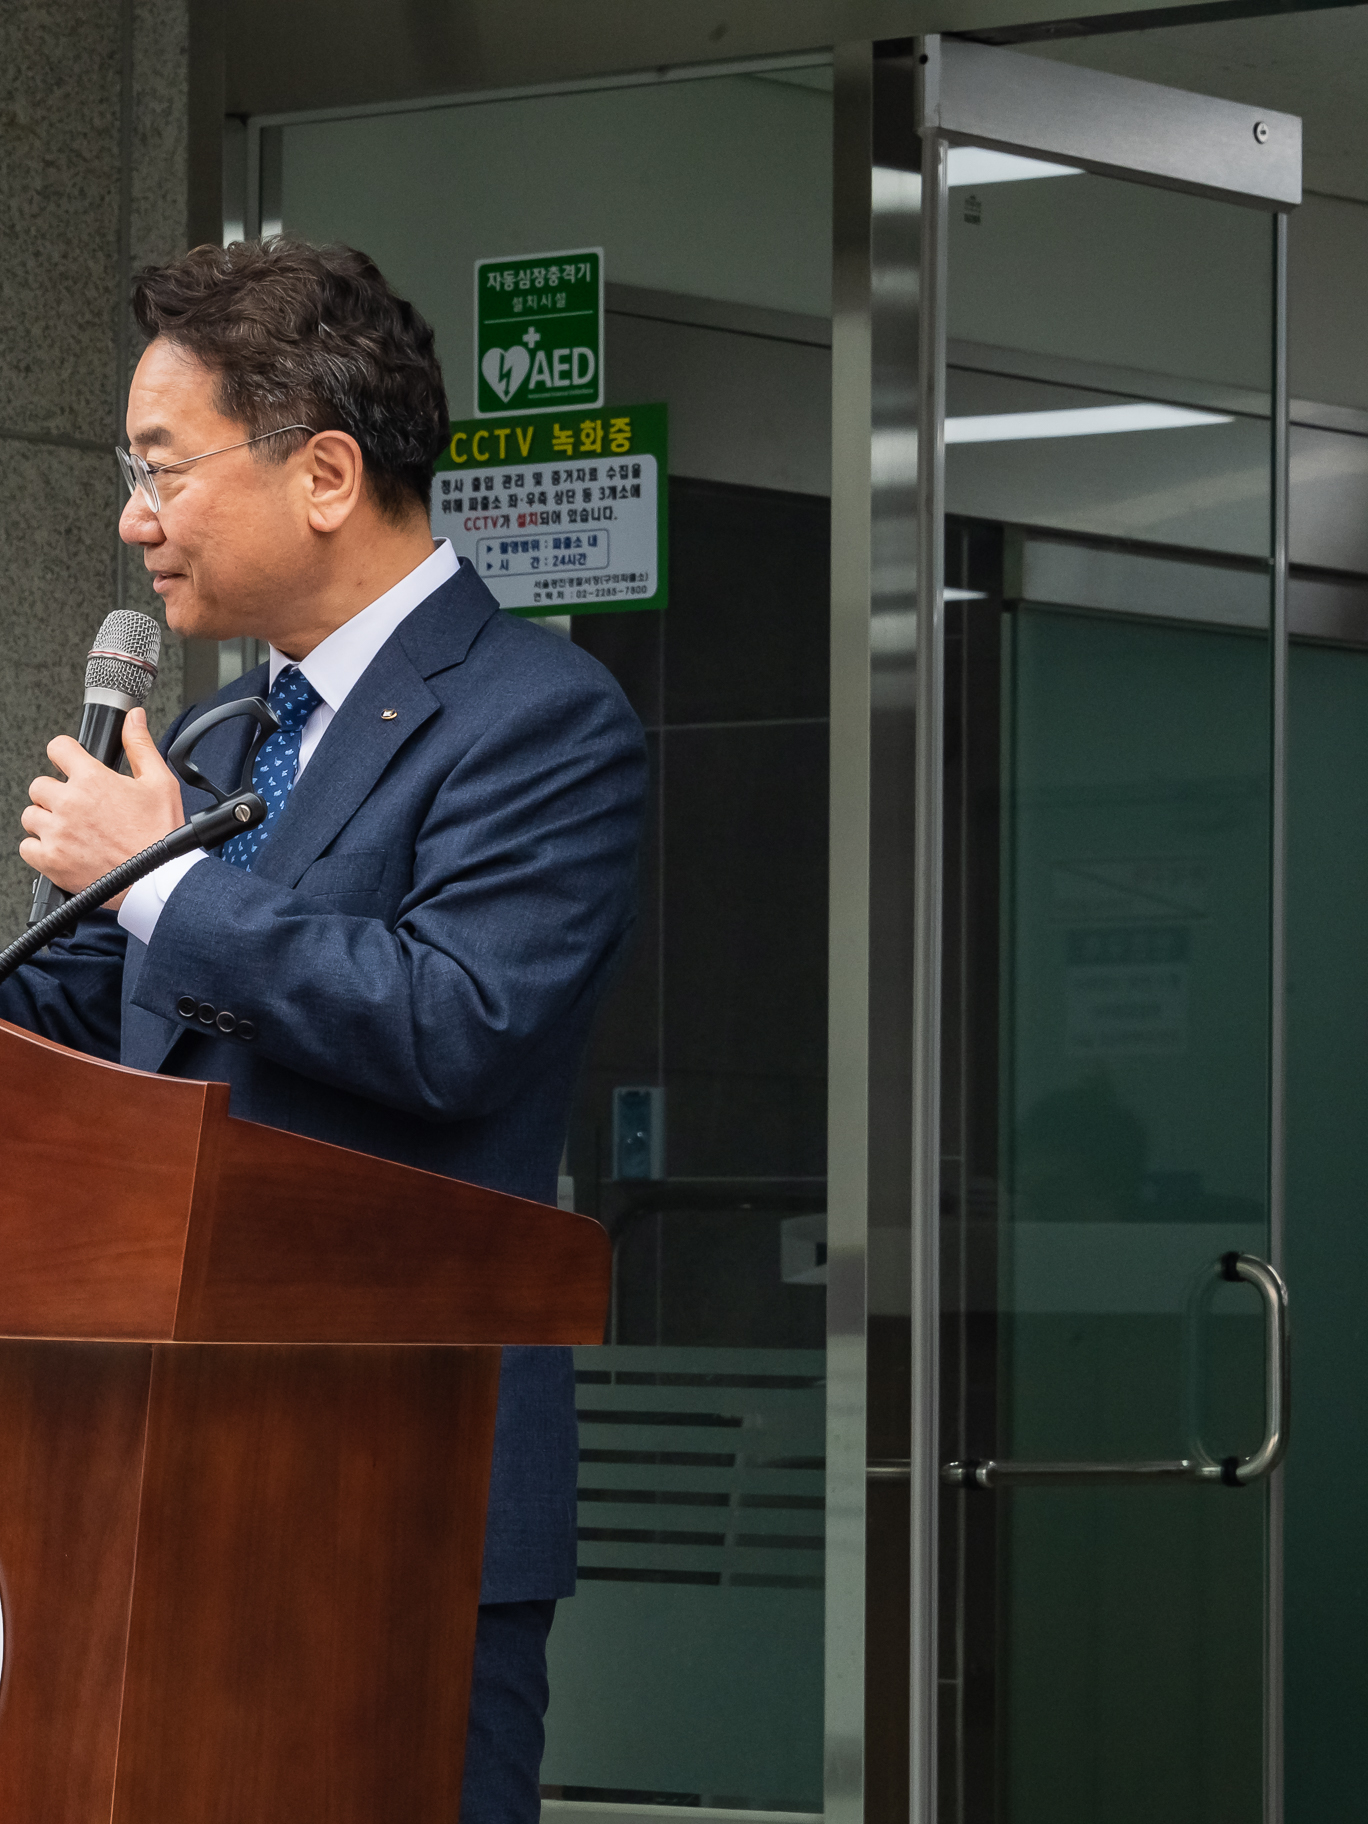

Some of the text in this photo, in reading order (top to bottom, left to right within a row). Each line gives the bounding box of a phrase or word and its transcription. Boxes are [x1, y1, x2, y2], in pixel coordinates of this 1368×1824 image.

[486, 262, 592, 292] 자동심장충격기
[511, 292, 567, 313] 설치시설
[528, 346, 596, 390] AED
[449, 416, 632, 464] CCTV 녹화중
[440, 463, 642, 495] 청사 출입 관리 및 증거자료 수집을
[440, 498, 463, 515] 위해
[467, 495, 502, 512] 파출소
[552, 488, 576, 506] 상단
[581, 487, 593, 503] 등
[598, 483, 642, 501] 3개소에
[463, 506, 619, 533] CCTV가 설치되어 있습니다.
[552, 536, 583, 550] 파출소
[587, 534, 598, 547] 내
[552, 552, 587, 567] 24시간
